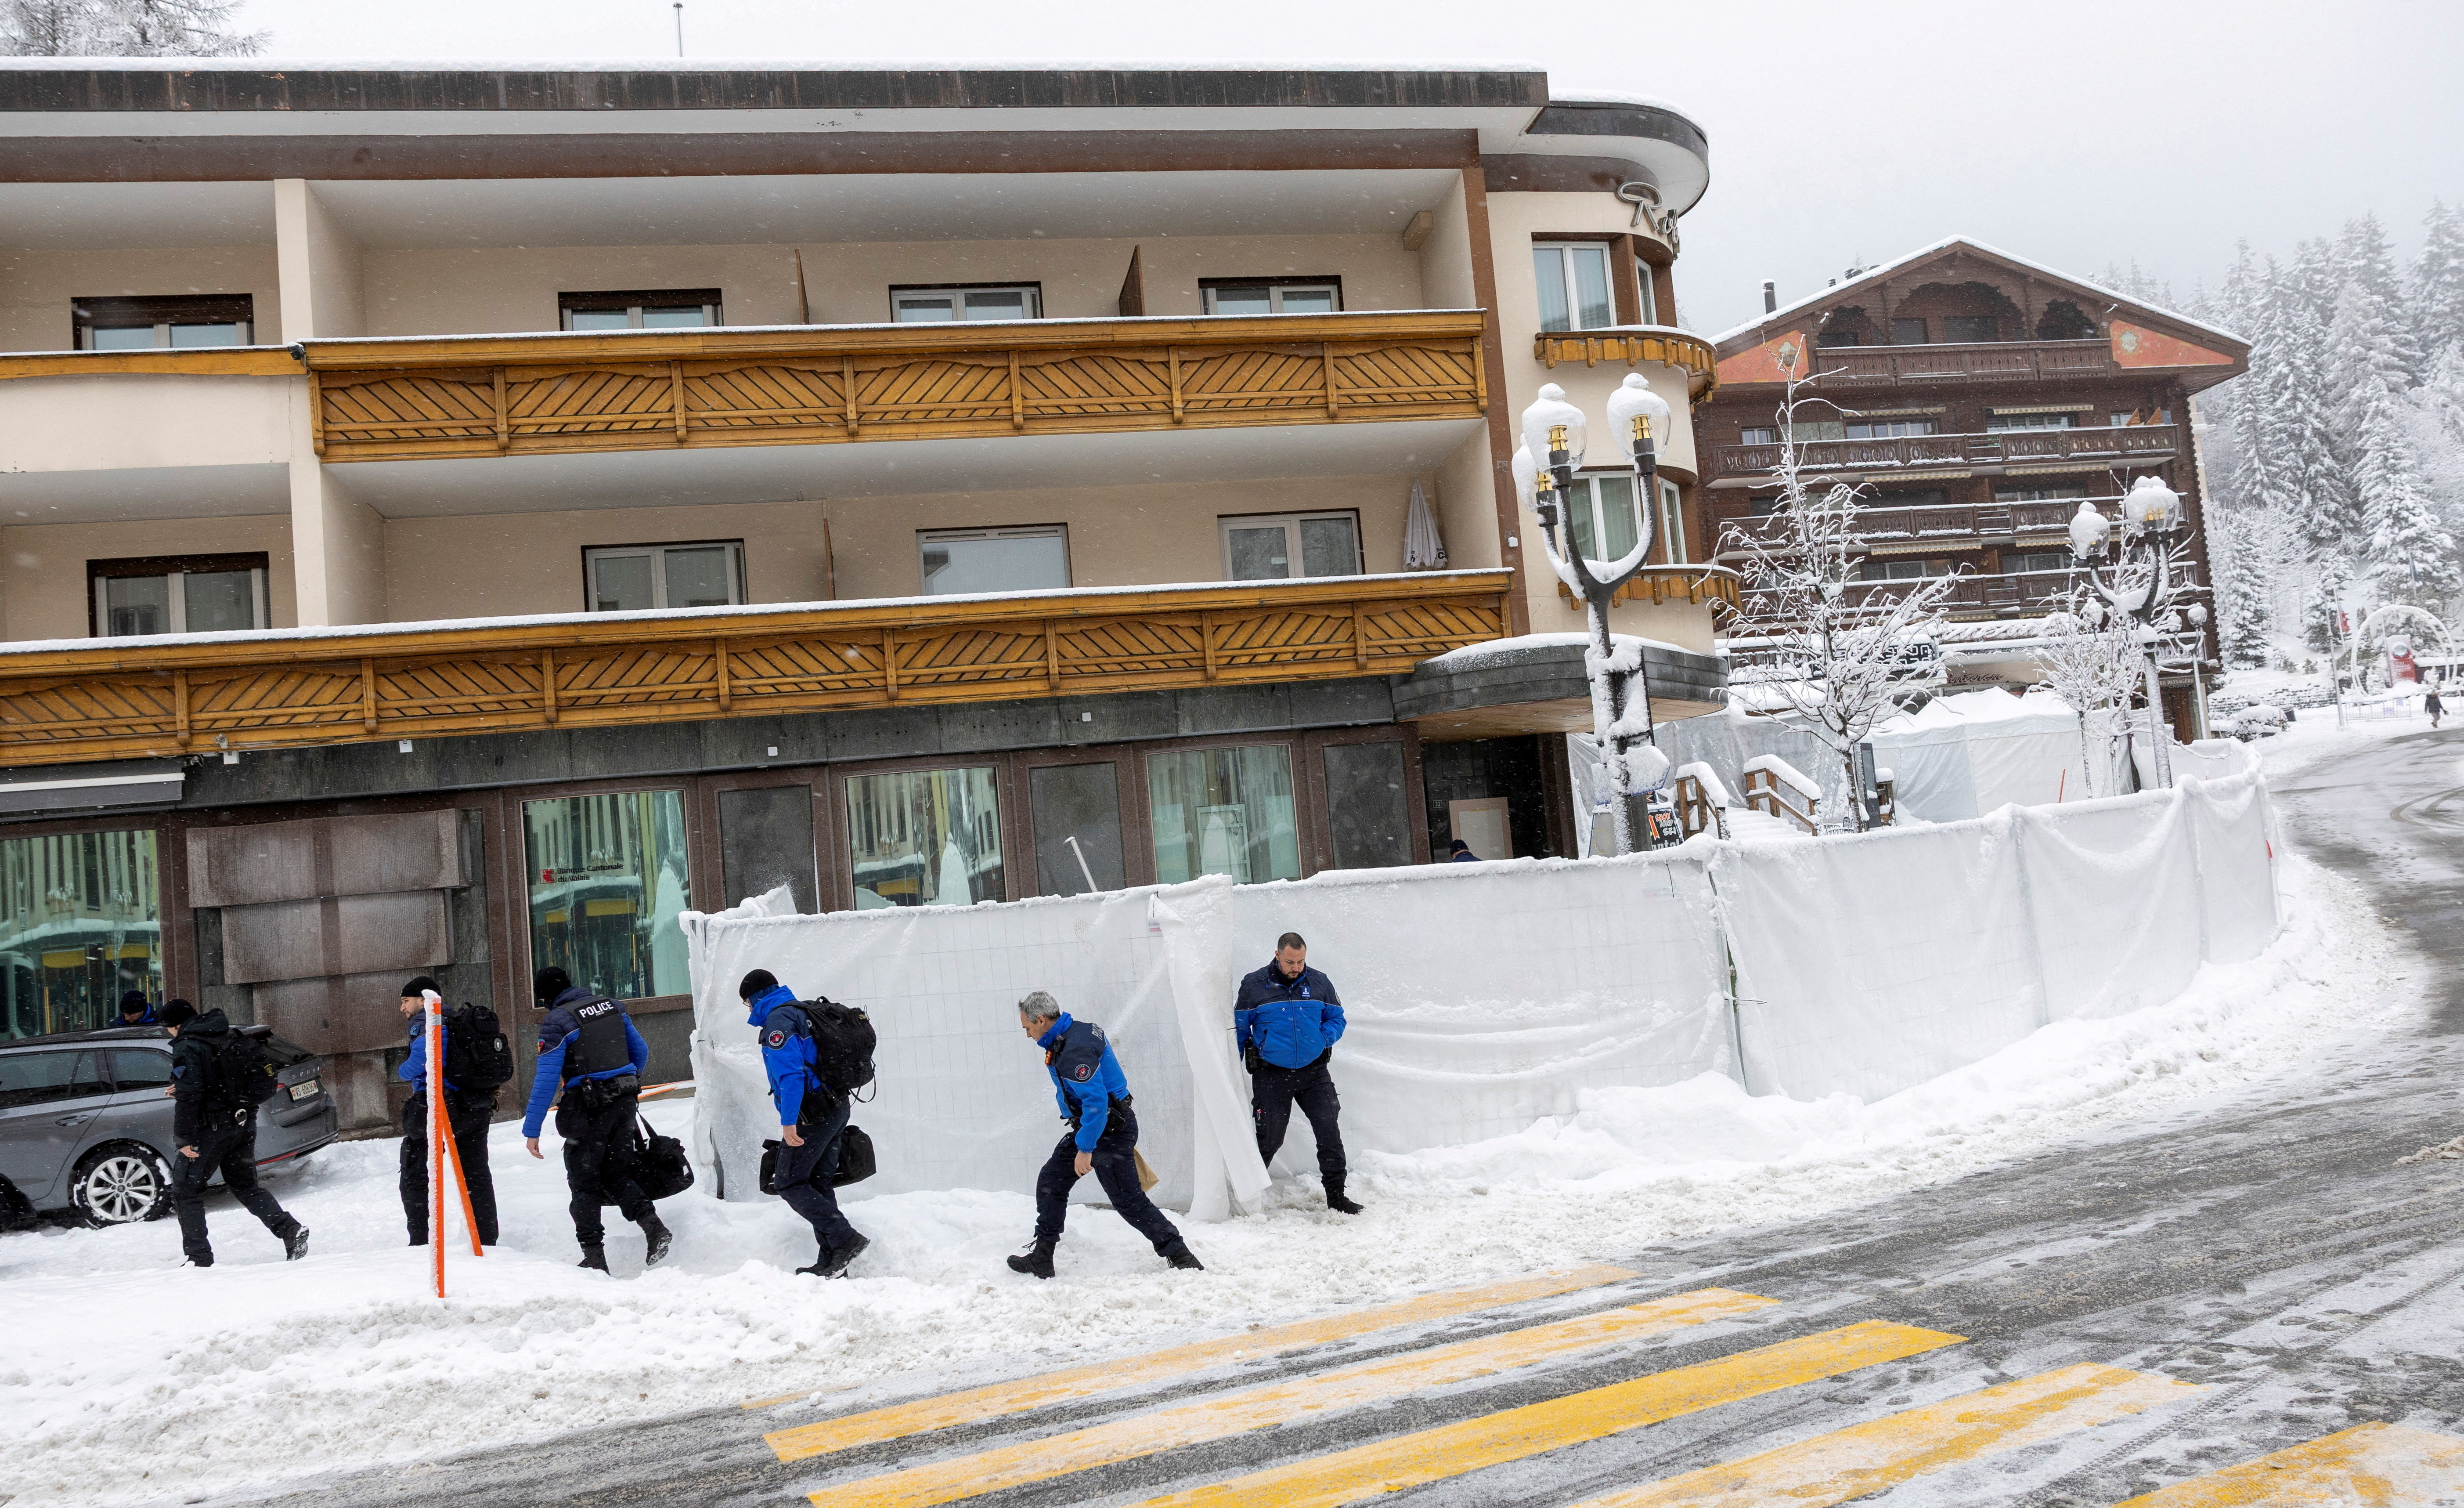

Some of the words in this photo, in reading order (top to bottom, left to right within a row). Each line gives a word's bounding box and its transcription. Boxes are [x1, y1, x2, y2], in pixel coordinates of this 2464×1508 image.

[1663, 827, 1677, 836] SKI
[587, 863, 624, 872] Cantonale
[579, 1002, 613, 1018] POLICE
